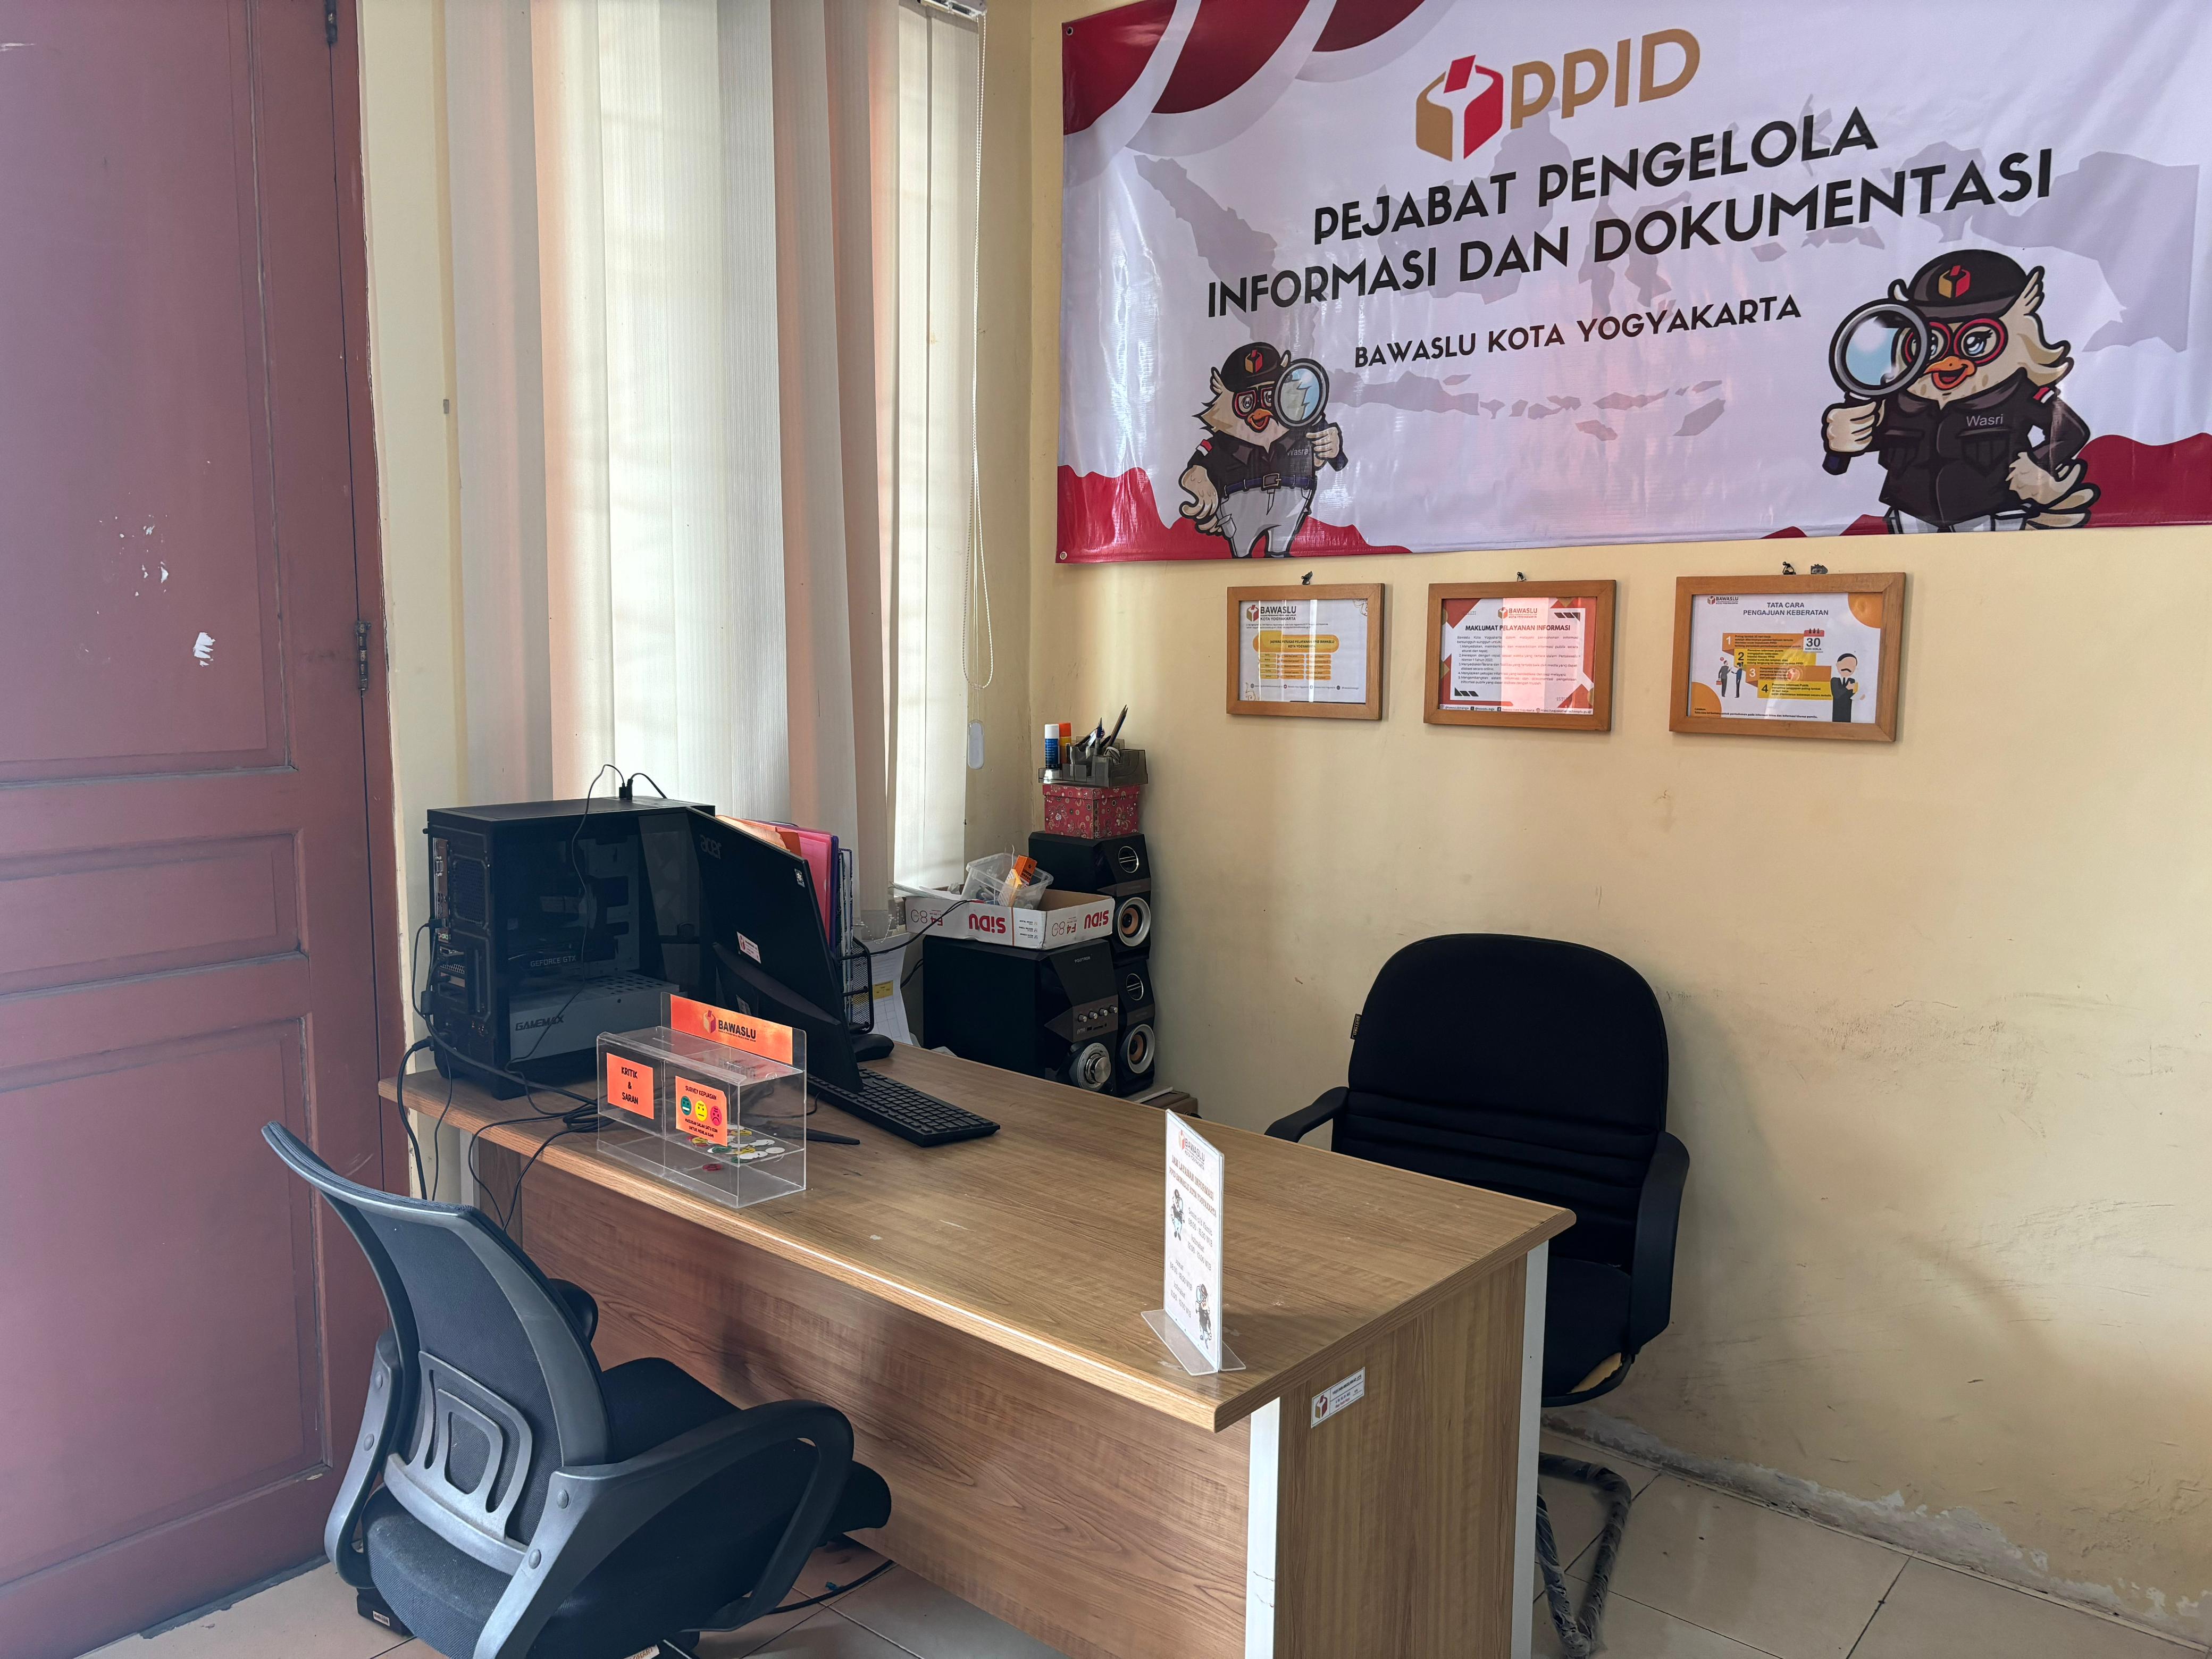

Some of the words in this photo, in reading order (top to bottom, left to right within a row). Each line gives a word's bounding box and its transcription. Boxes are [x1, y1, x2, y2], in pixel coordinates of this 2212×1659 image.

[1510, 28, 1700, 129] PPID
[1314, 172, 1516, 245] PEJABAT
[1539, 107, 1878, 206] PENGELOLA
[1208, 249, 1437, 317] INFORMASI
[1459, 226, 1569, 283] DAN
[1594, 148, 2052, 262] DOKUMENTASI
[1354, 333, 1476, 368] BAWASLU
[1489, 324, 1565, 353] KOTA
[1577, 295, 1802, 343] YOGYAKARTA
[1966, 413, 2004, 427] Wasri
[1287, 447, 1309, 456] Wasra
[1726, 636, 1731, 645] 1
[1806, 638, 1821, 647] 30
[1738, 652, 1745, 661] 2
[1749, 668, 1756, 677] 3
[1761, 684, 1769, 693] 4
[1066, 920, 1077, 934] F4
[530, 958, 561, 968] GEFORCE
[515, 1015, 565, 1032] GAMEMAX
[718, 1019, 756, 1040] BAWASLU
[621, 1066, 638, 1079] KRITIK
[622, 1092, 639, 1105] SARAN
[685, 1085, 699, 1095] SURVEY
[699, 1090, 717, 1101] KEPUASAN
[1185, 1137, 1205, 1162] BAWASLU
[1178, 1161, 1194, 1182] LAYANAN
[1194, 1175, 1214, 1201] INFORMASI
[1176, 1173, 1189, 1192] BAWASLU
[1197, 1193, 1217, 1218] YOGYAKARTA
